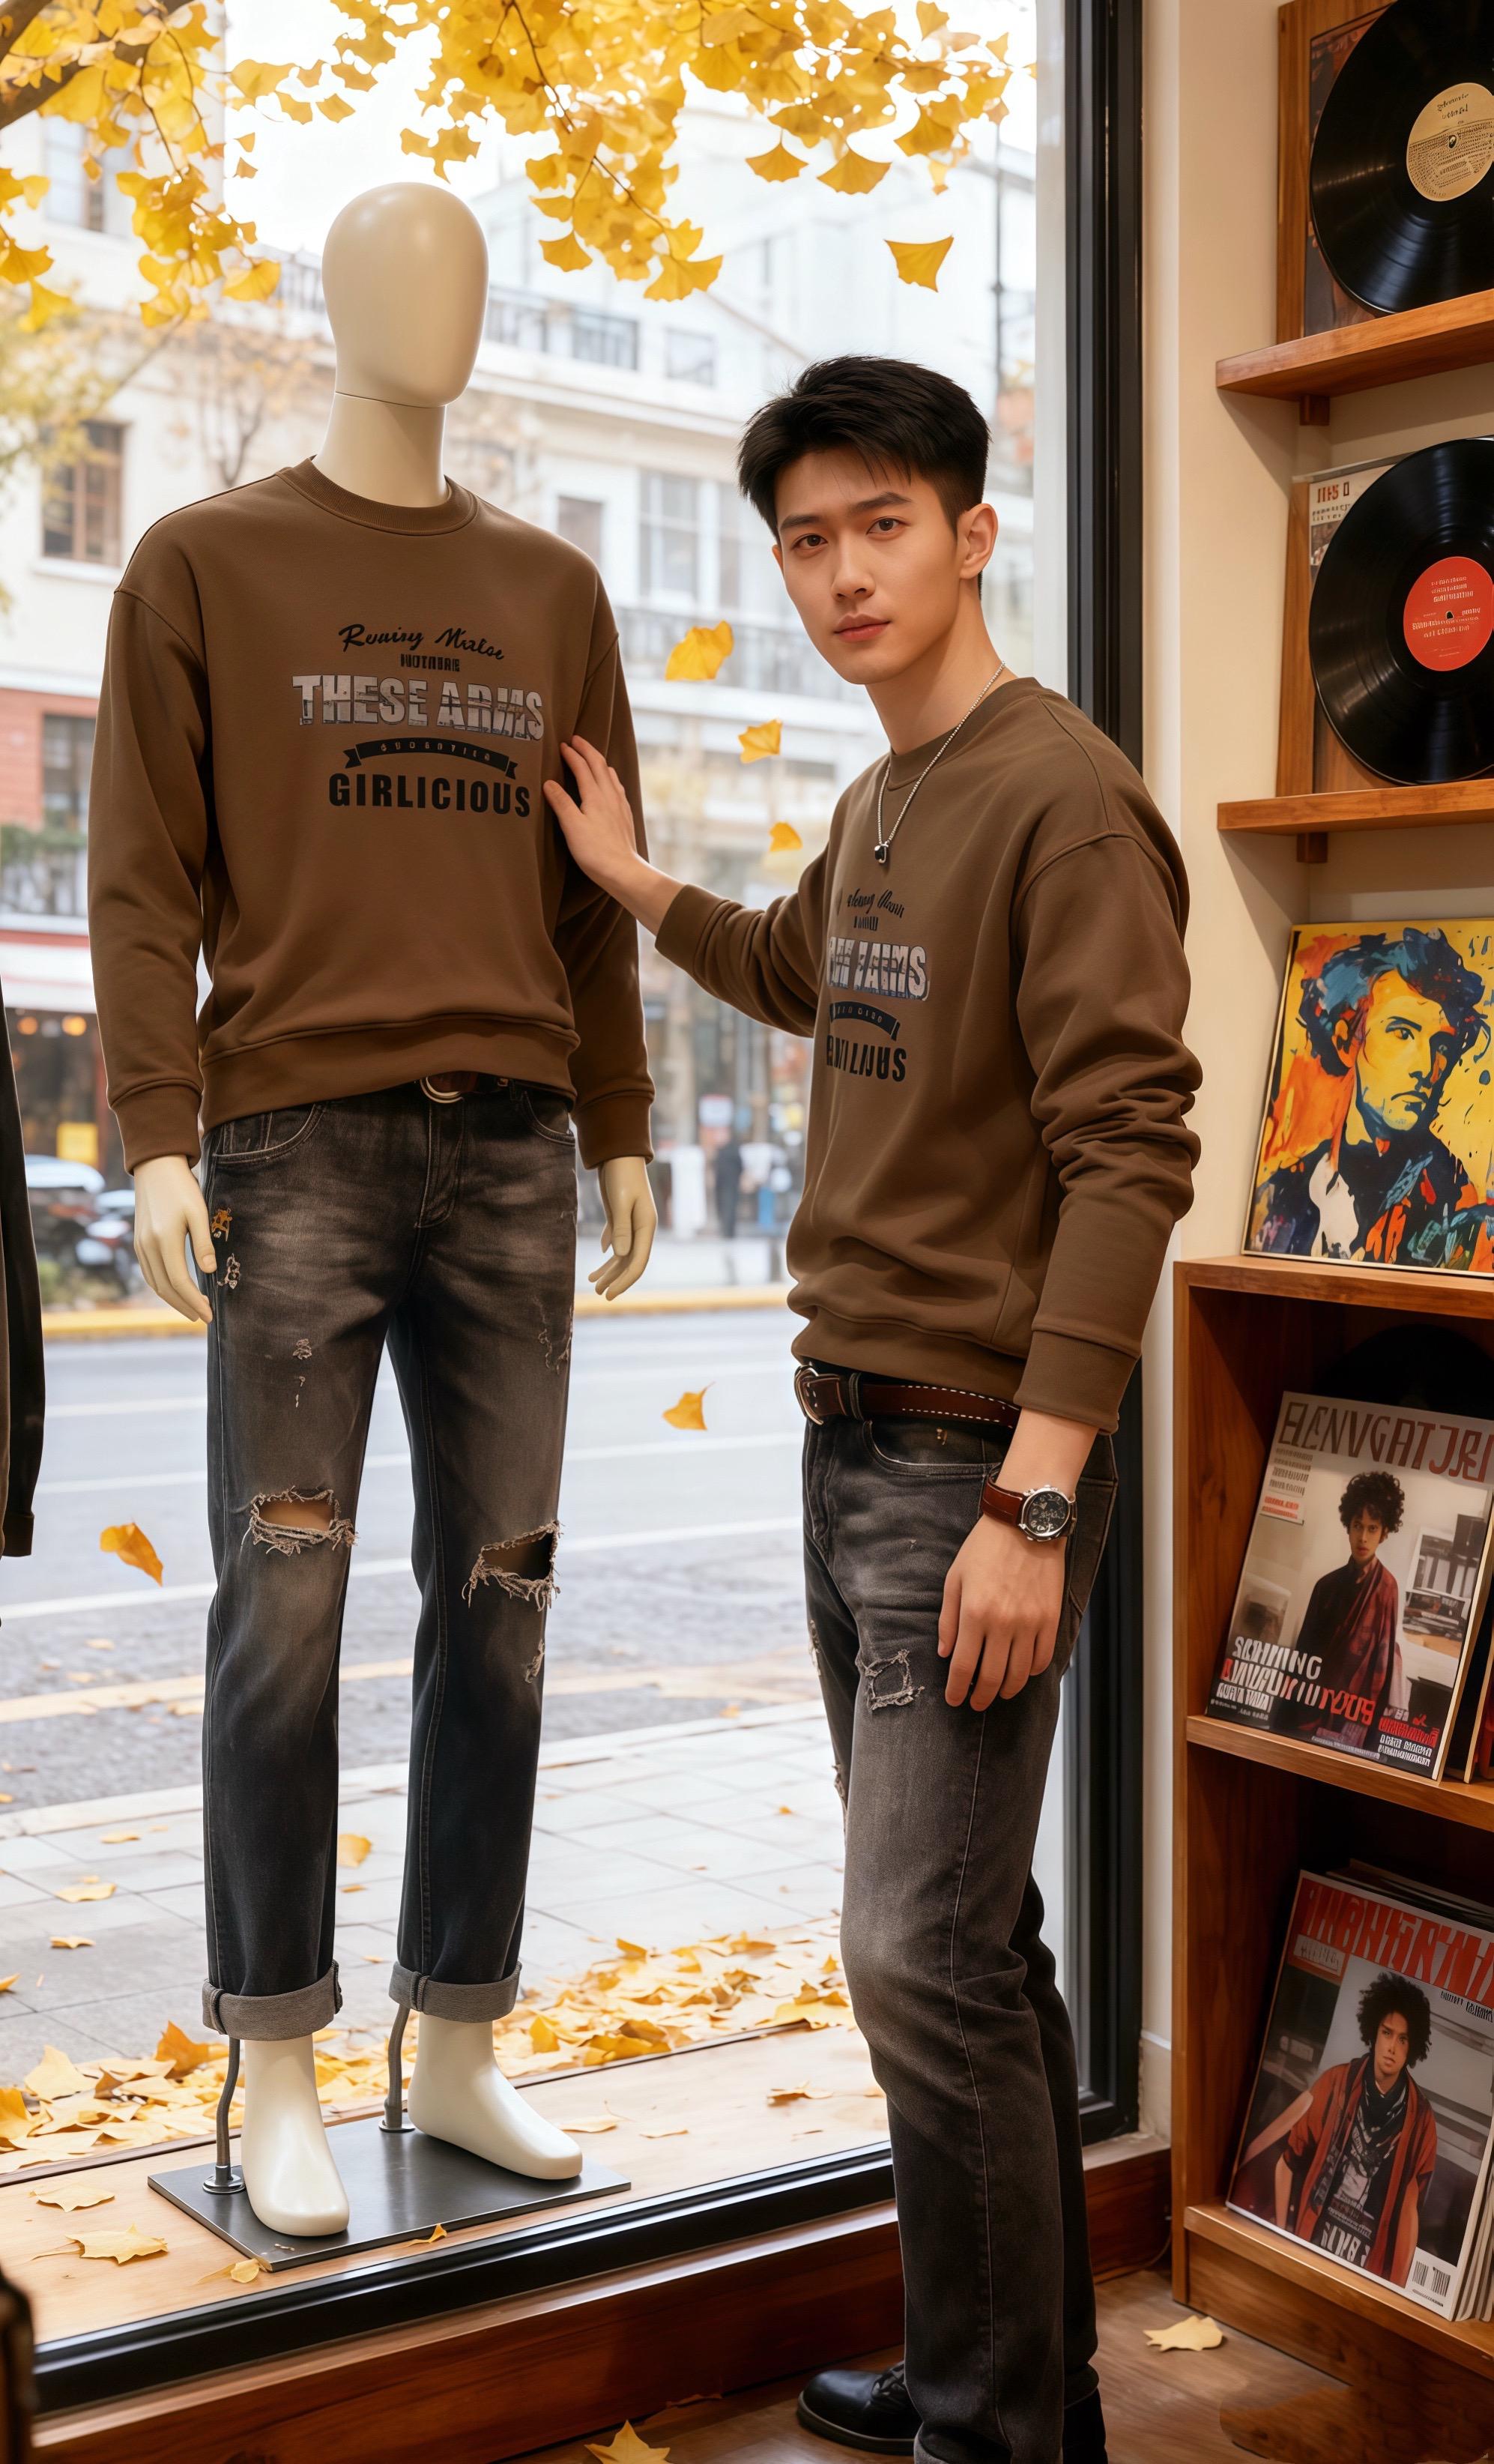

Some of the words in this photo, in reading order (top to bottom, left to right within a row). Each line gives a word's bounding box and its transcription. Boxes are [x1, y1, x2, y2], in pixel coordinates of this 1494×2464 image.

[292, 674, 429, 726] THESE
[437, 680, 545, 741] ARMS
[329, 772, 530, 818] GIRLICIOUS
